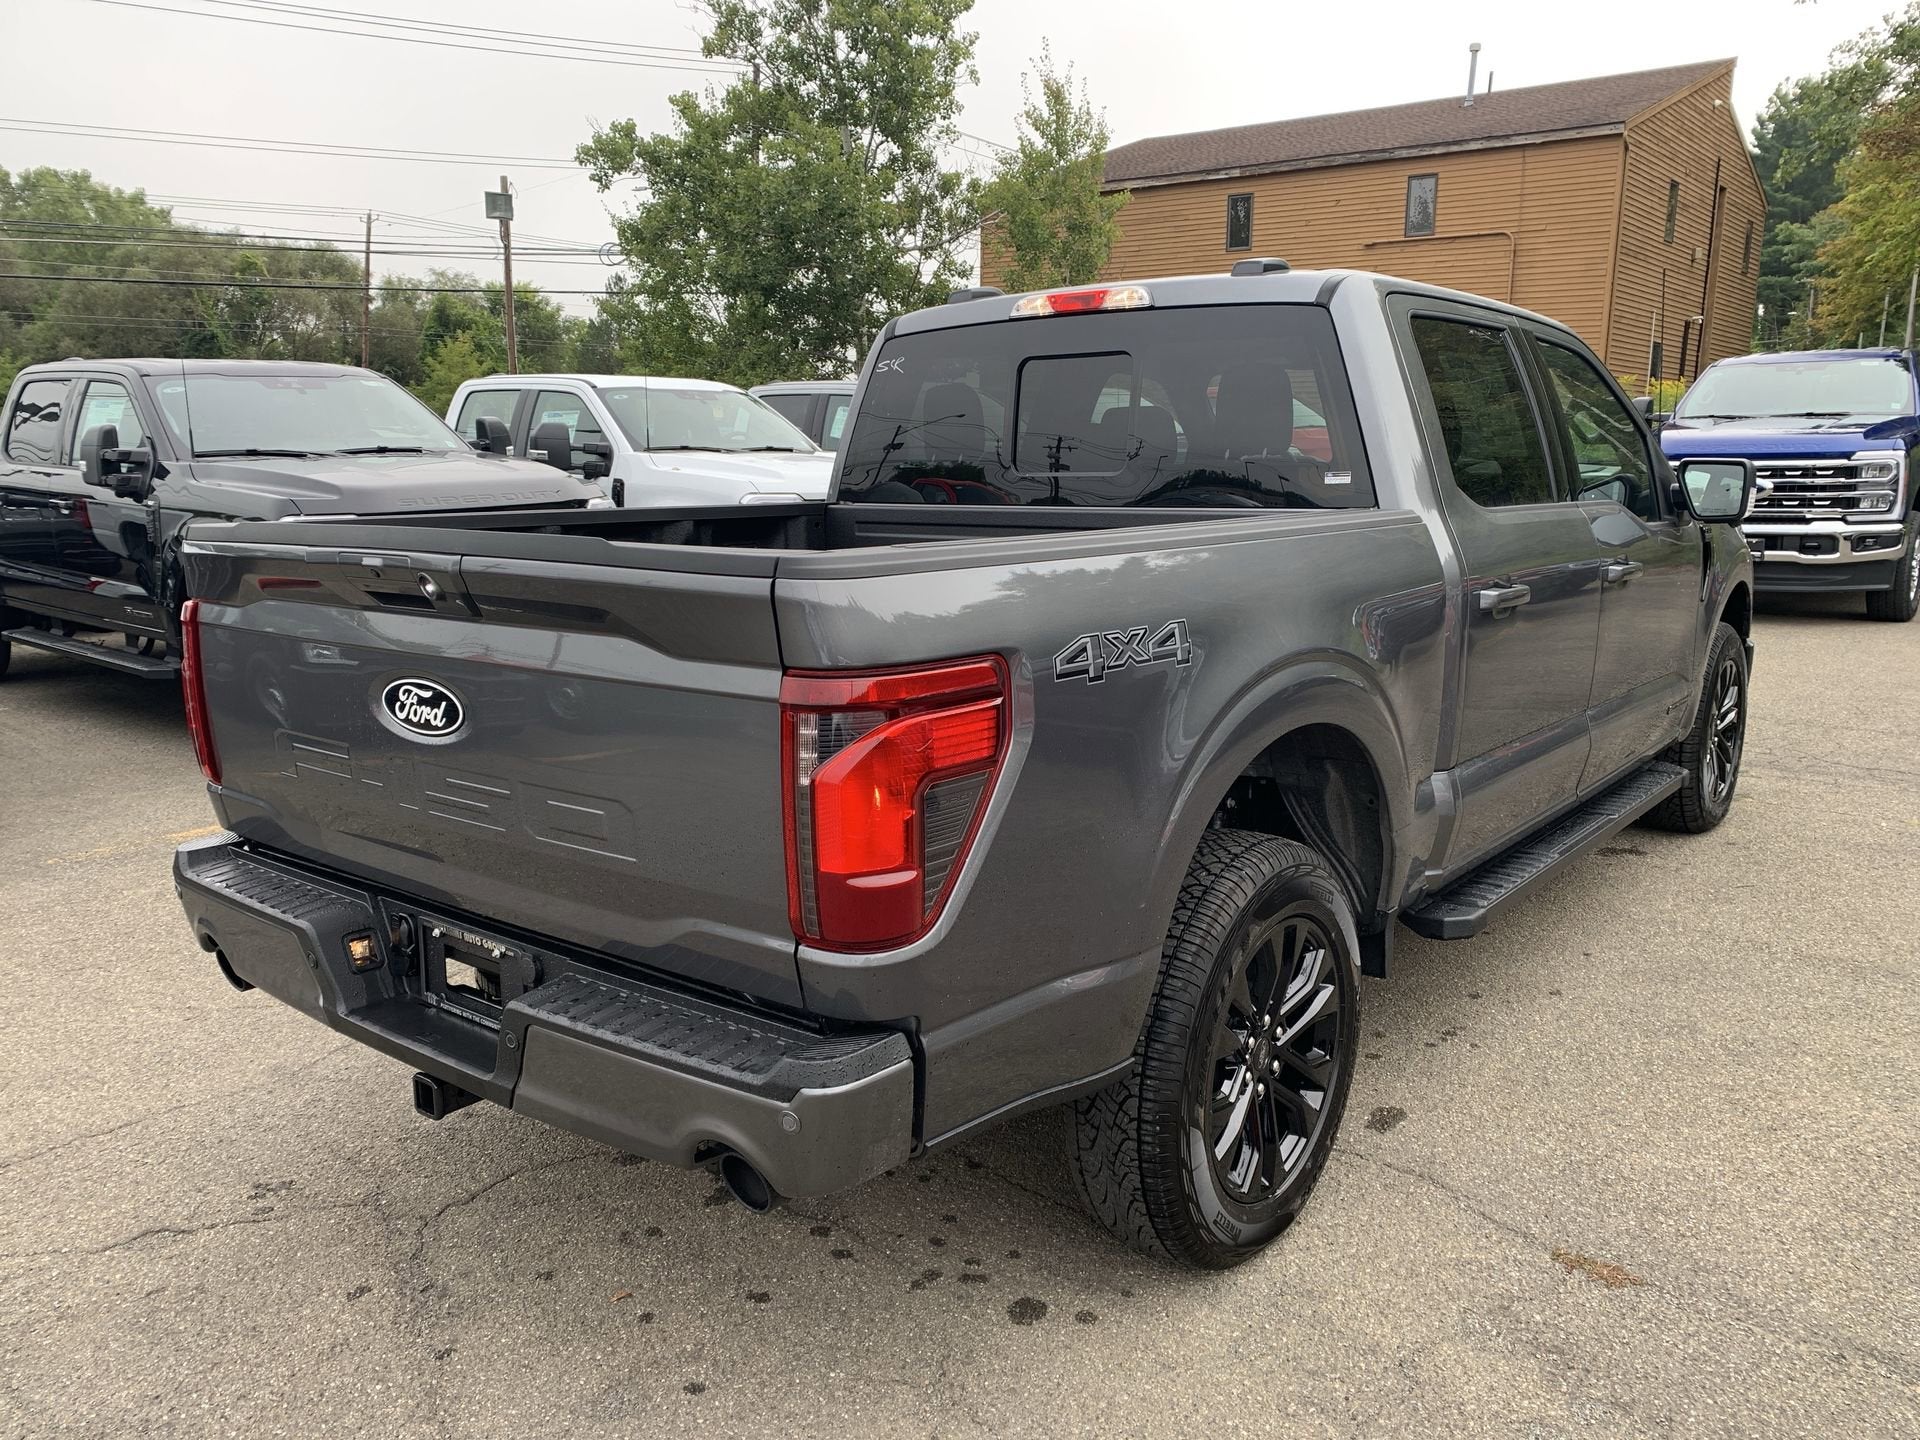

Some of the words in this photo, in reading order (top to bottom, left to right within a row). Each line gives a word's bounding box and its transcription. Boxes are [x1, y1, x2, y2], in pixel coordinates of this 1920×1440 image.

[399, 494, 497, 507] SUPER
[501, 489, 562, 502] DUTY
[395, 685, 447, 728] Ford
